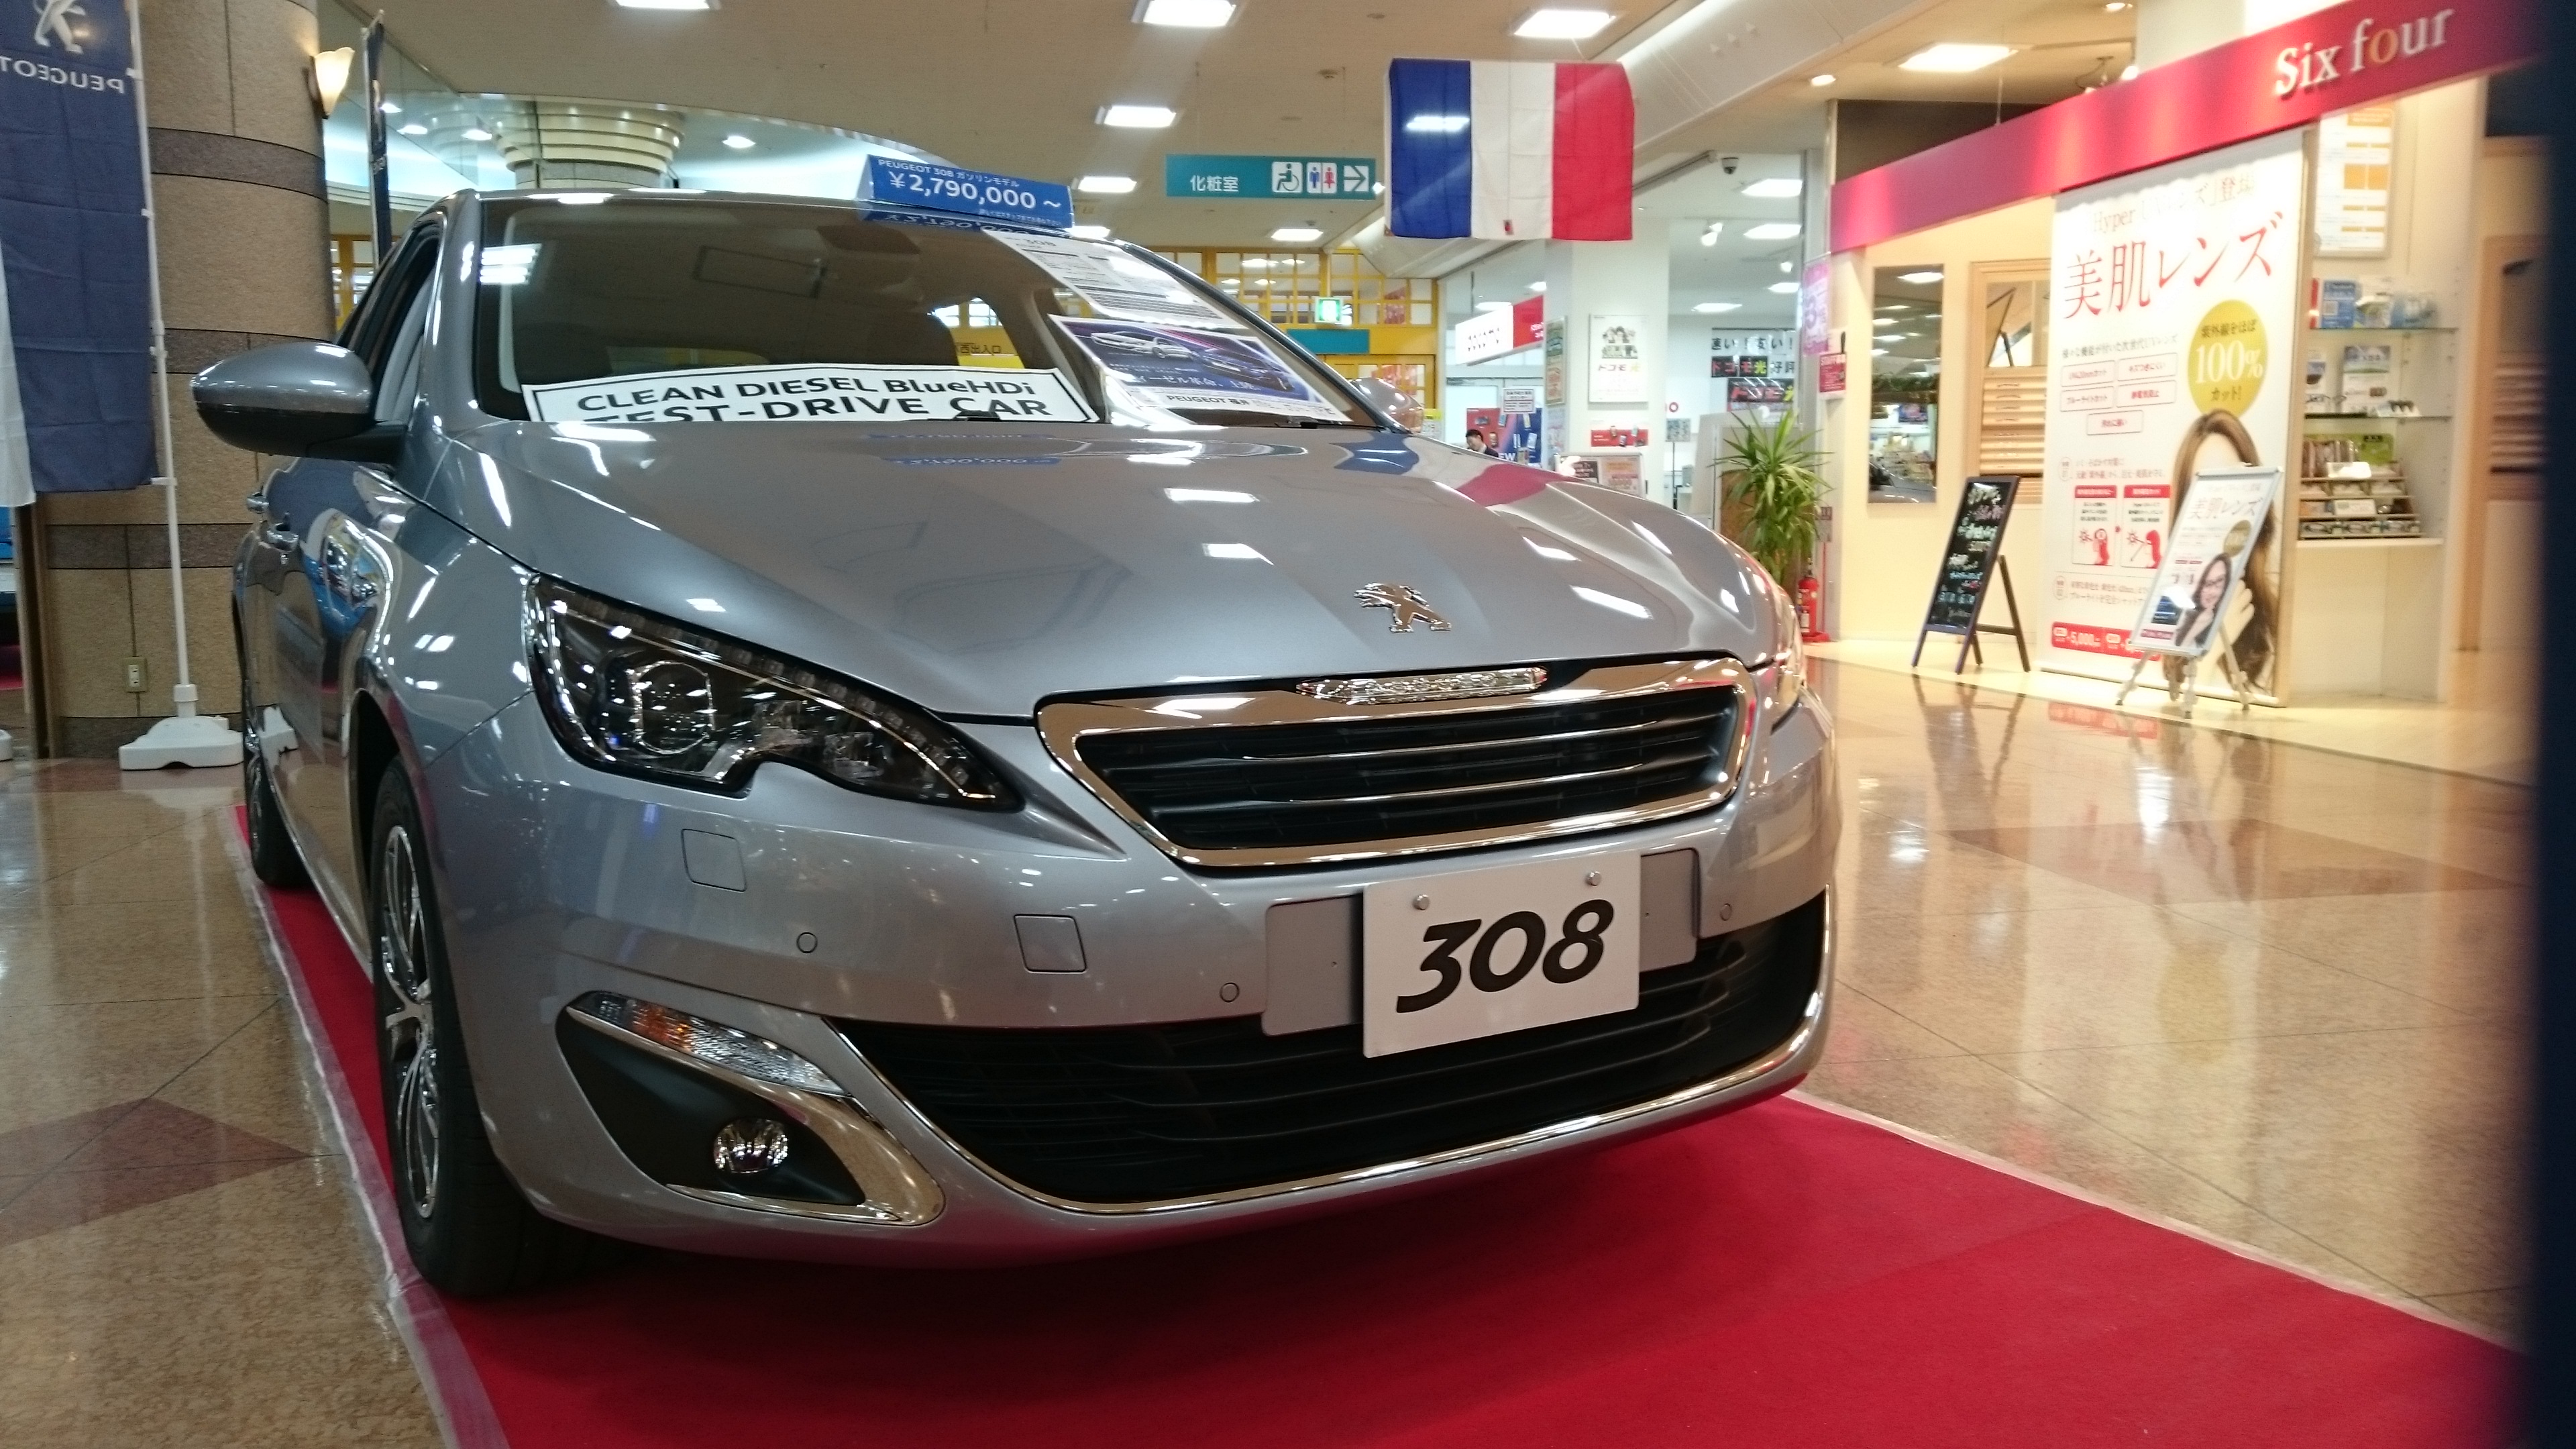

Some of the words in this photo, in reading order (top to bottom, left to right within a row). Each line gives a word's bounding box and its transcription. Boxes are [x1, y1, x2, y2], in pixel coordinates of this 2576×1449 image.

[2274, 42, 2343, 96] Six
[2351, 8, 2455, 72] four
[878, 158, 931, 174] PEUGEOT
[934, 168, 953, 177] 308
[957, 170, 1020, 187] ガソリンモデル
[1190, 174, 1239, 192] 化粧室
[888, 170, 1036, 209] ¥2,790,000
[2093, 208, 2136, 234] Hyper
[2063, 211, 2284, 319] 美肌レンズ
[2195, 339, 2263, 384] 100%
[578, 384, 730, 411] CLEAN
[736, 376, 877, 396] DIESEL
[882, 378, 1036, 395] BlueHDi
[950, 397, 1053, 416] CAR
[1167, 394, 1226, 404] PEUGEOT
[1499, 452, 1516, 462] EW
[1396, 898, 1614, 1014] 308
